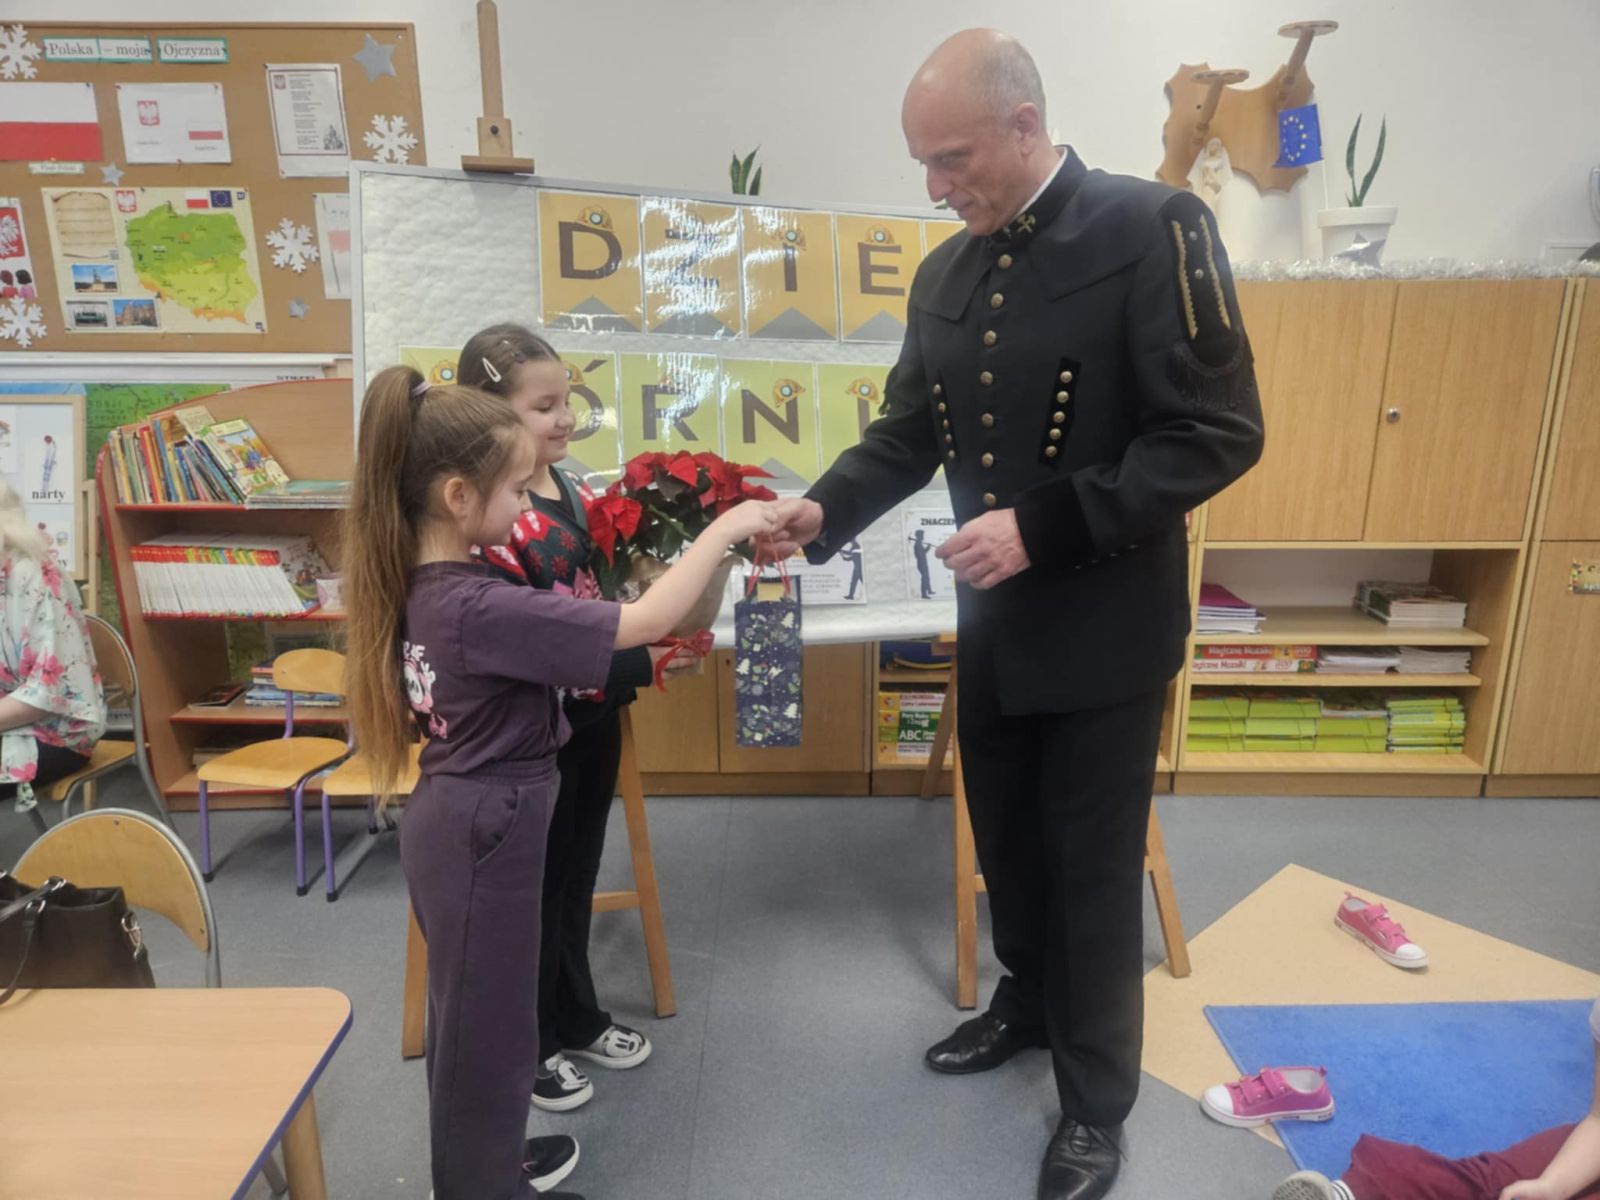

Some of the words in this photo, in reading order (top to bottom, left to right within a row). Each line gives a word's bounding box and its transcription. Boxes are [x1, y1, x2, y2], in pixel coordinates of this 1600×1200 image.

[49, 43, 93, 56] Polska
[116, 43, 149, 58] moja
[163, 43, 221, 58] Ojczyzna
[31, 490, 65, 503] narty
[899, 730, 921, 740] ABC
